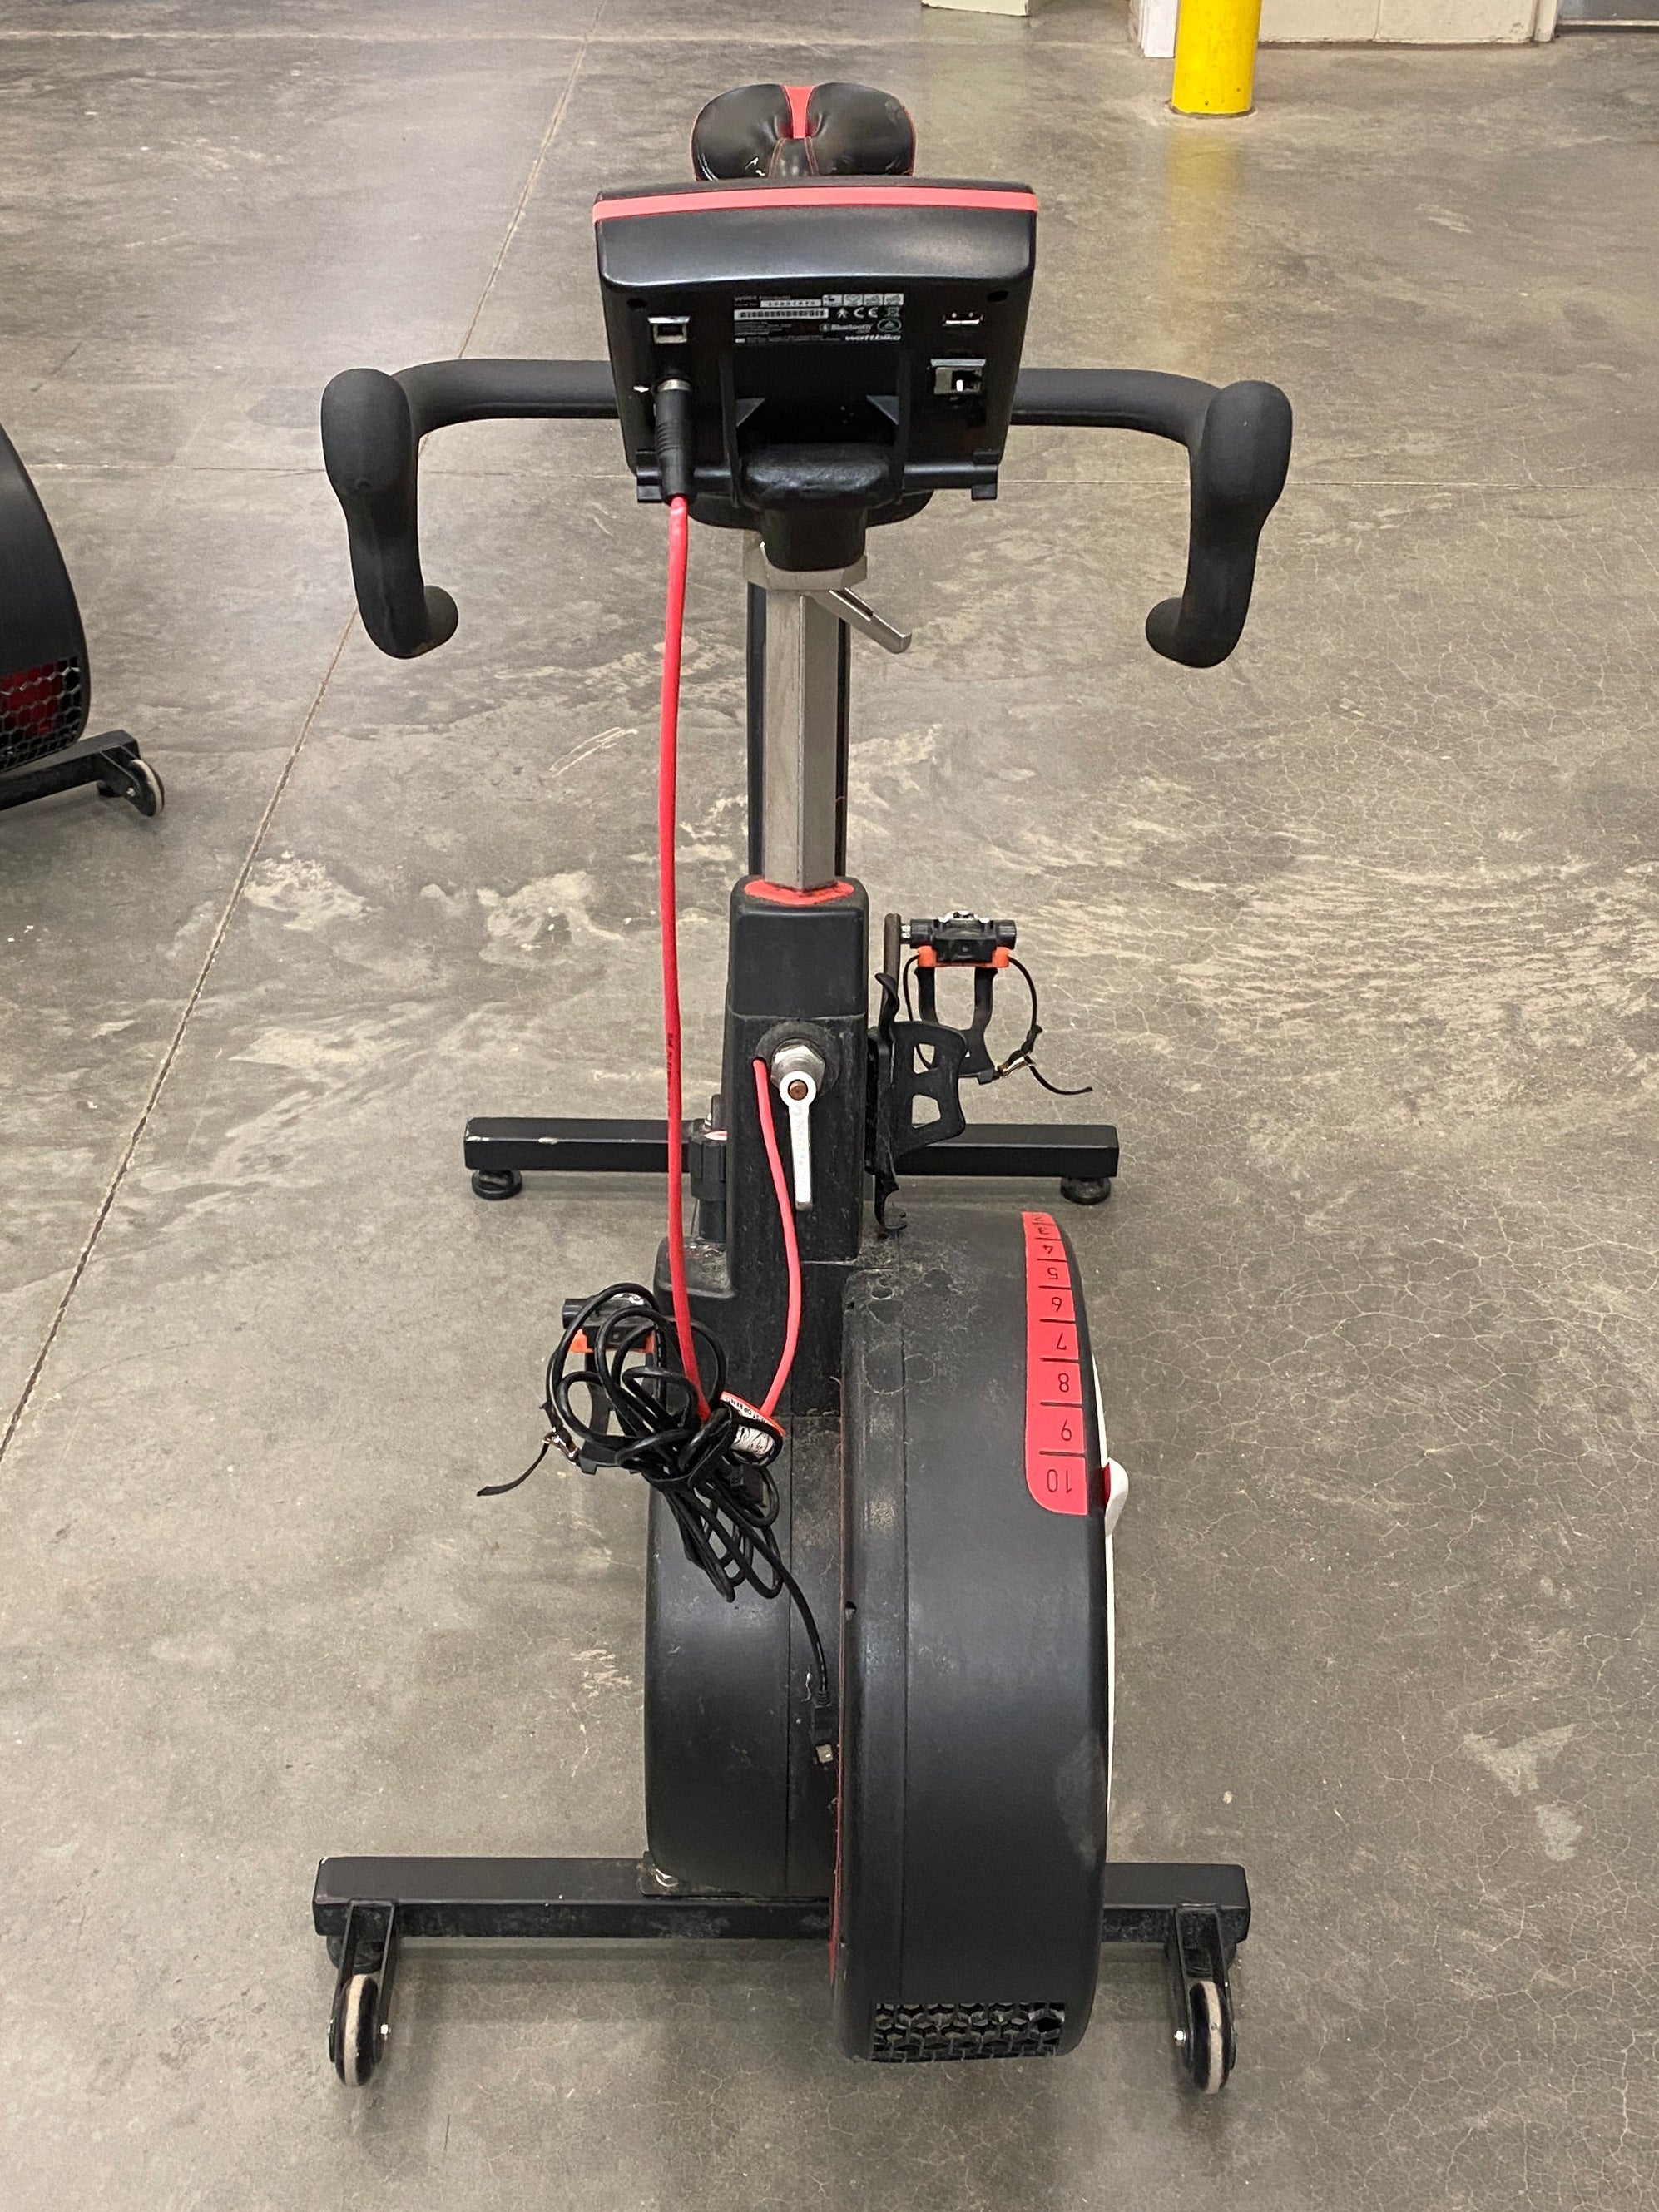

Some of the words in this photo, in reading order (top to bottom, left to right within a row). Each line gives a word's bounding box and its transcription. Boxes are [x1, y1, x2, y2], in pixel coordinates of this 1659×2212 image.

[1042, 1244, 1054, 1254] 4
[1047, 1267, 1059, 1280] 5
[1051, 1296, 1062, 1312] 6
[1056, 1332, 1067, 1351] 7
[1057, 1373, 1070, 1393] 8
[1060, 1419, 1072, 1442] 9
[1047, 1469, 1072, 1494] 10
